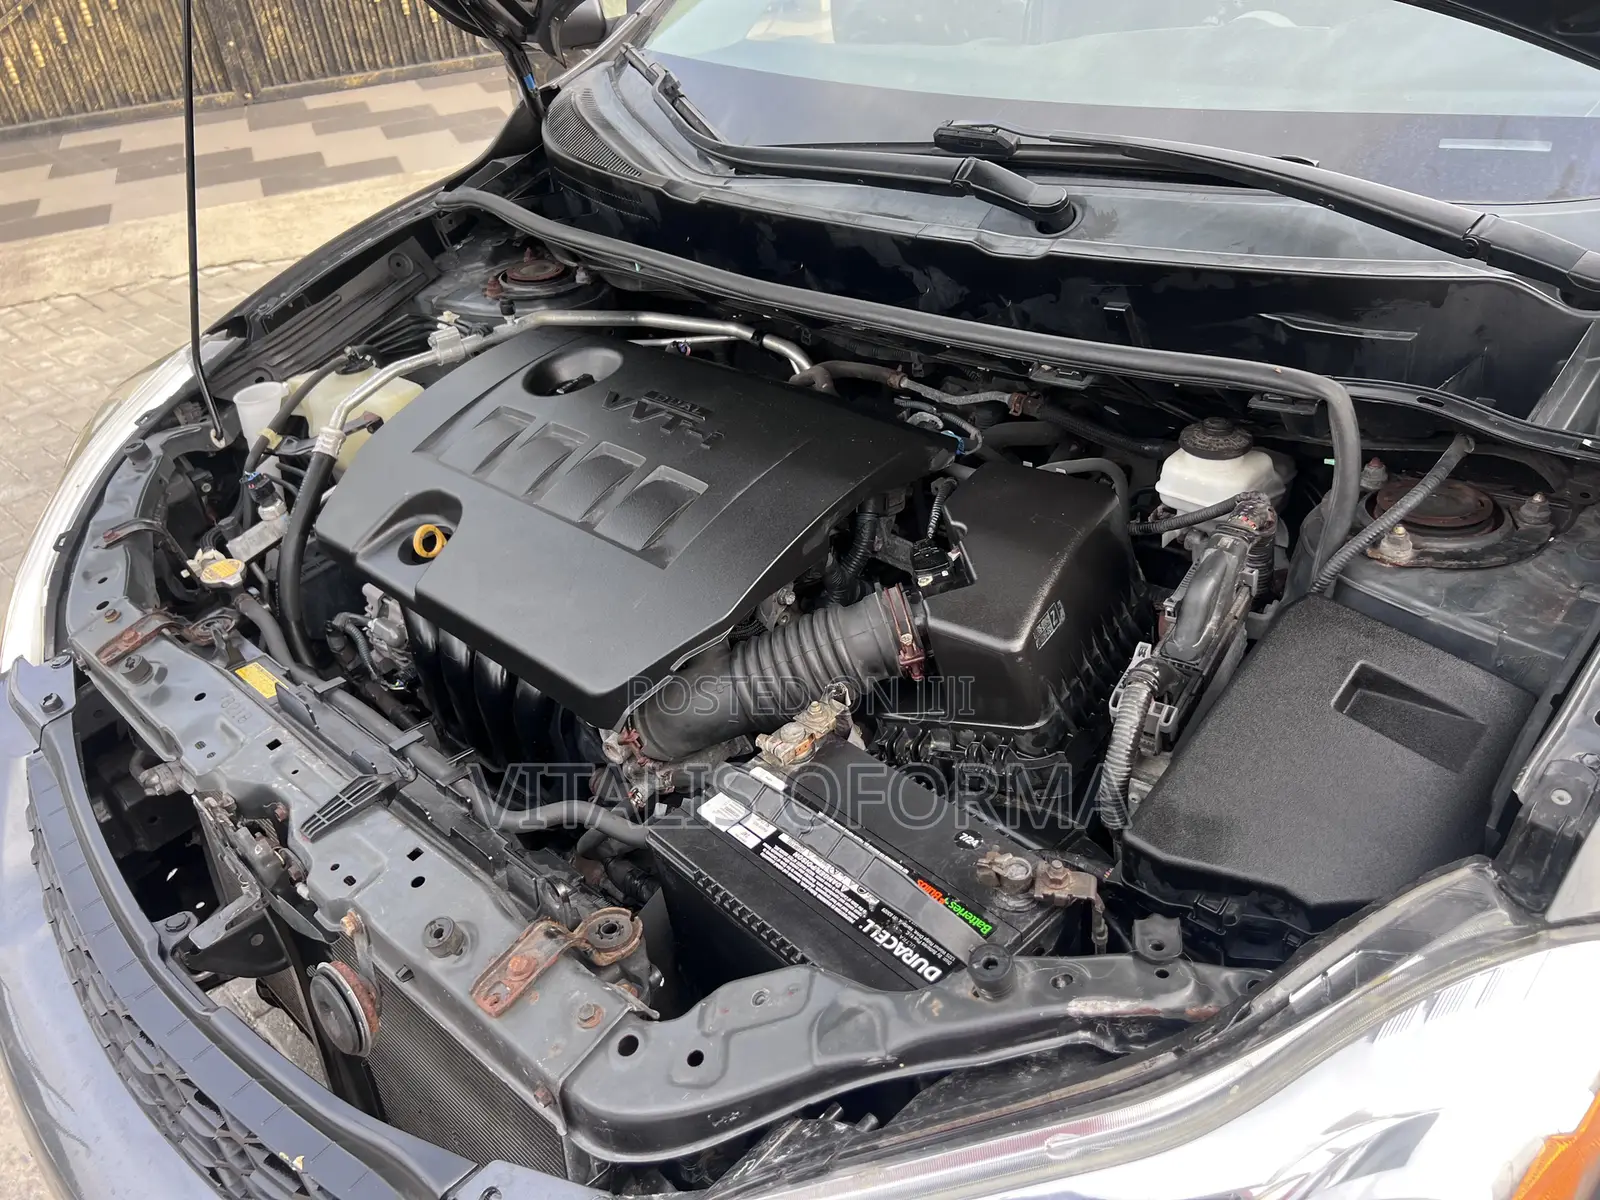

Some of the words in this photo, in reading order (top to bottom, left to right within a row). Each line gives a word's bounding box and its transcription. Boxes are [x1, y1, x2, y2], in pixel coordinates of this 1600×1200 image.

[949, 901, 993, 935] Batteries
[862, 919, 942, 982] DURACELL
[899, 934, 916, 949] ULTRA
